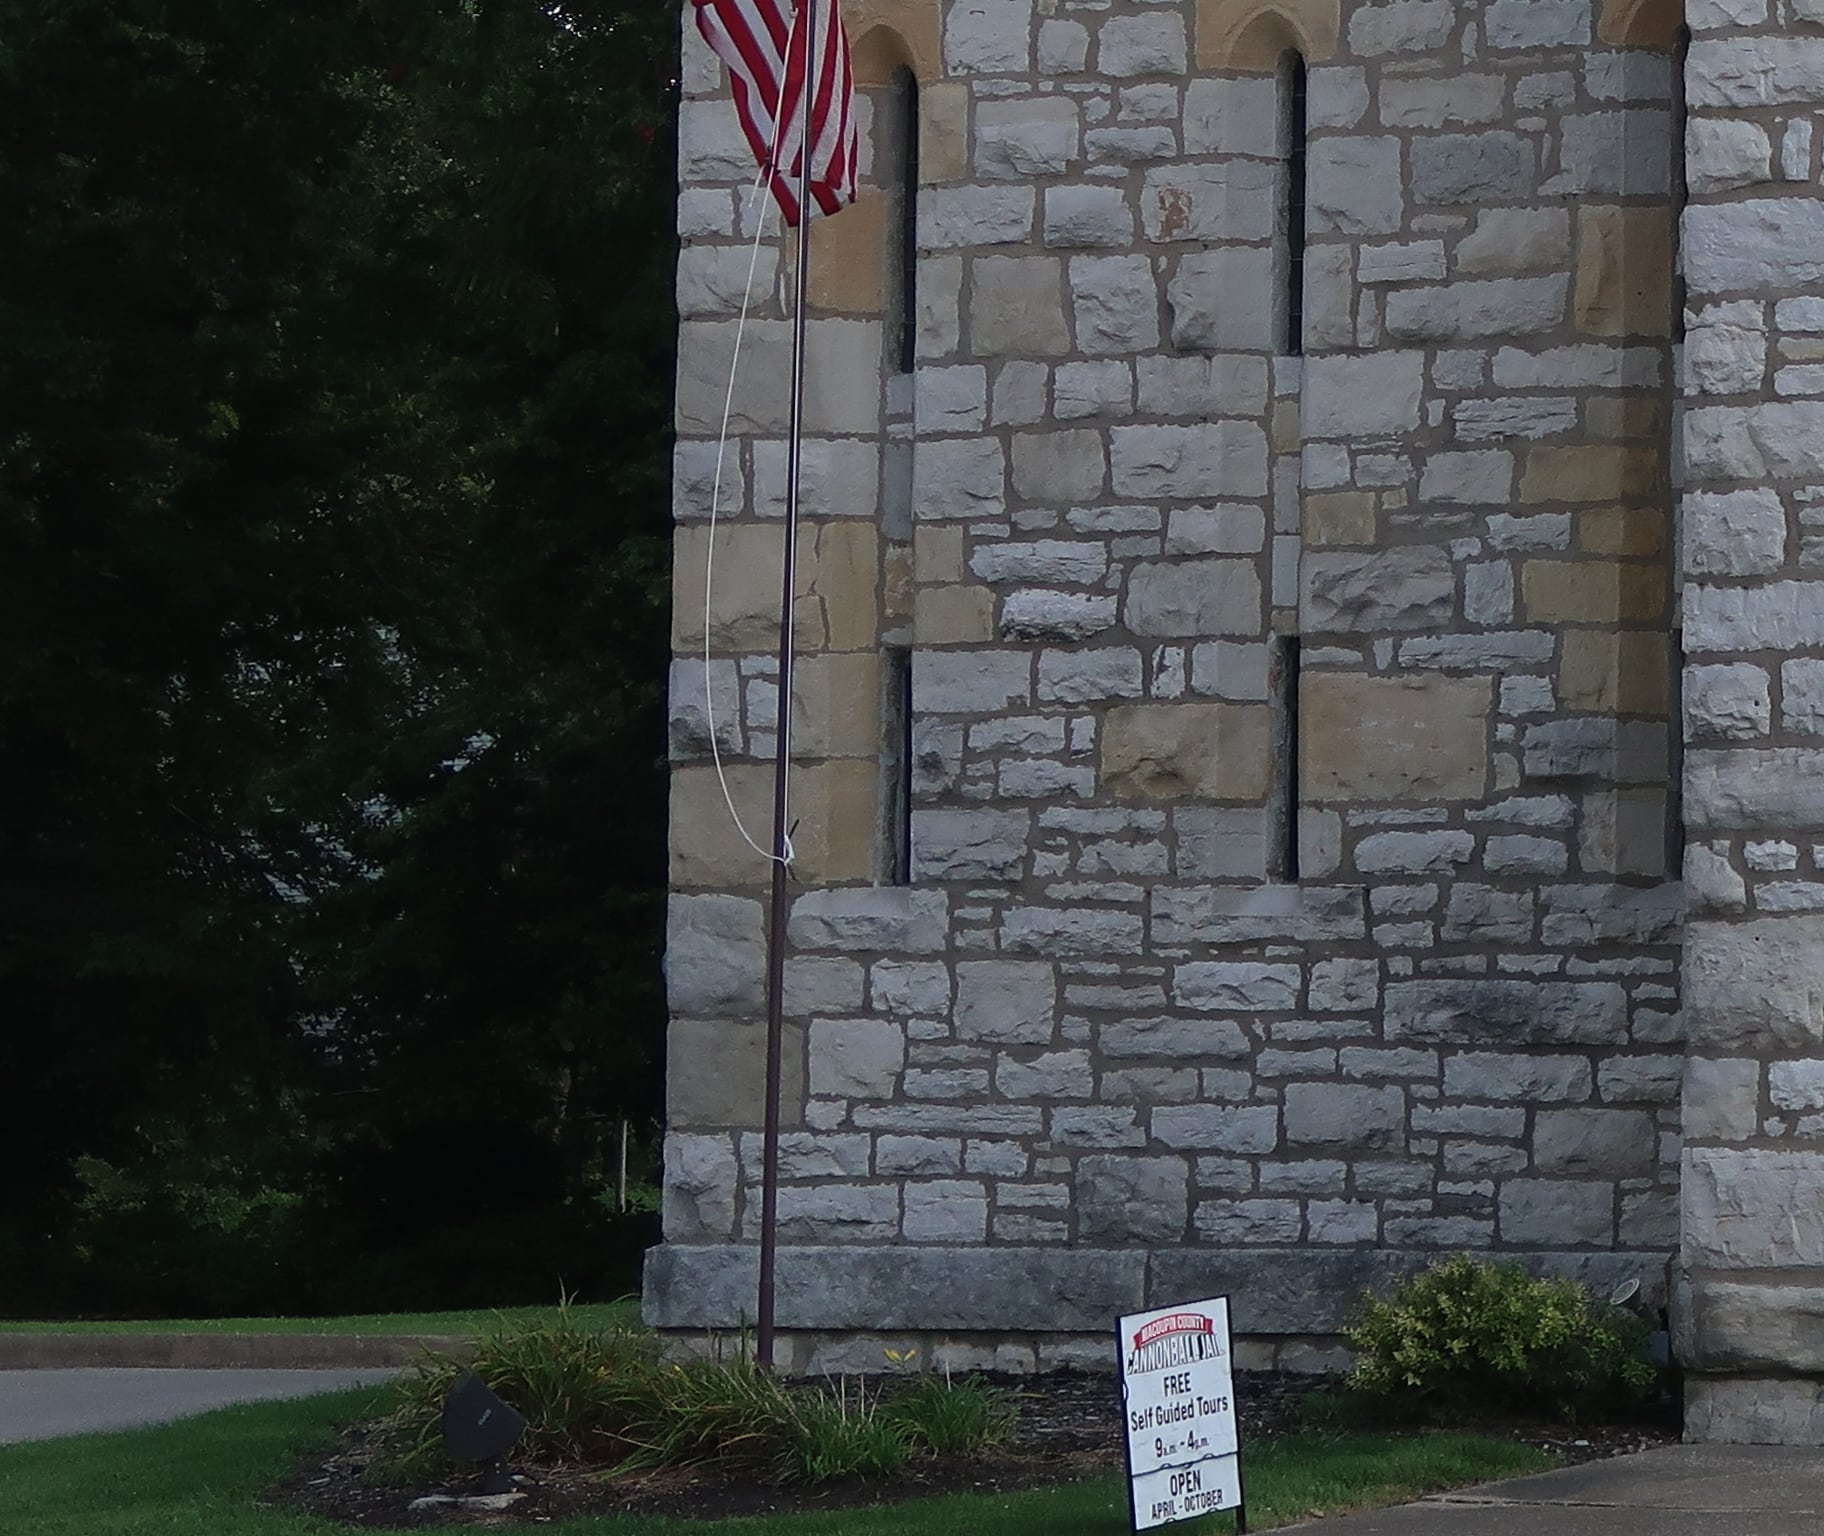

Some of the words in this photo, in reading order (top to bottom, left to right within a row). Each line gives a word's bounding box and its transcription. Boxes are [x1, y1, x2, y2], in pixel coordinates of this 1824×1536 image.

[1127, 1335, 1201, 1375] CANNONBALL
[1200, 1333, 1225, 1359] JAIL
[1163, 1372, 1192, 1397] FREE
[1130, 1407, 1153, 1431] Self
[1156, 1398, 1195, 1426] Guided
[1196, 1396, 1229, 1417] Tours
[1170, 1469, 1202, 1497] OPEN
[1151, 1500, 1177, 1520] APRIL
[1183, 1489, 1224, 1512] OCTOBER
